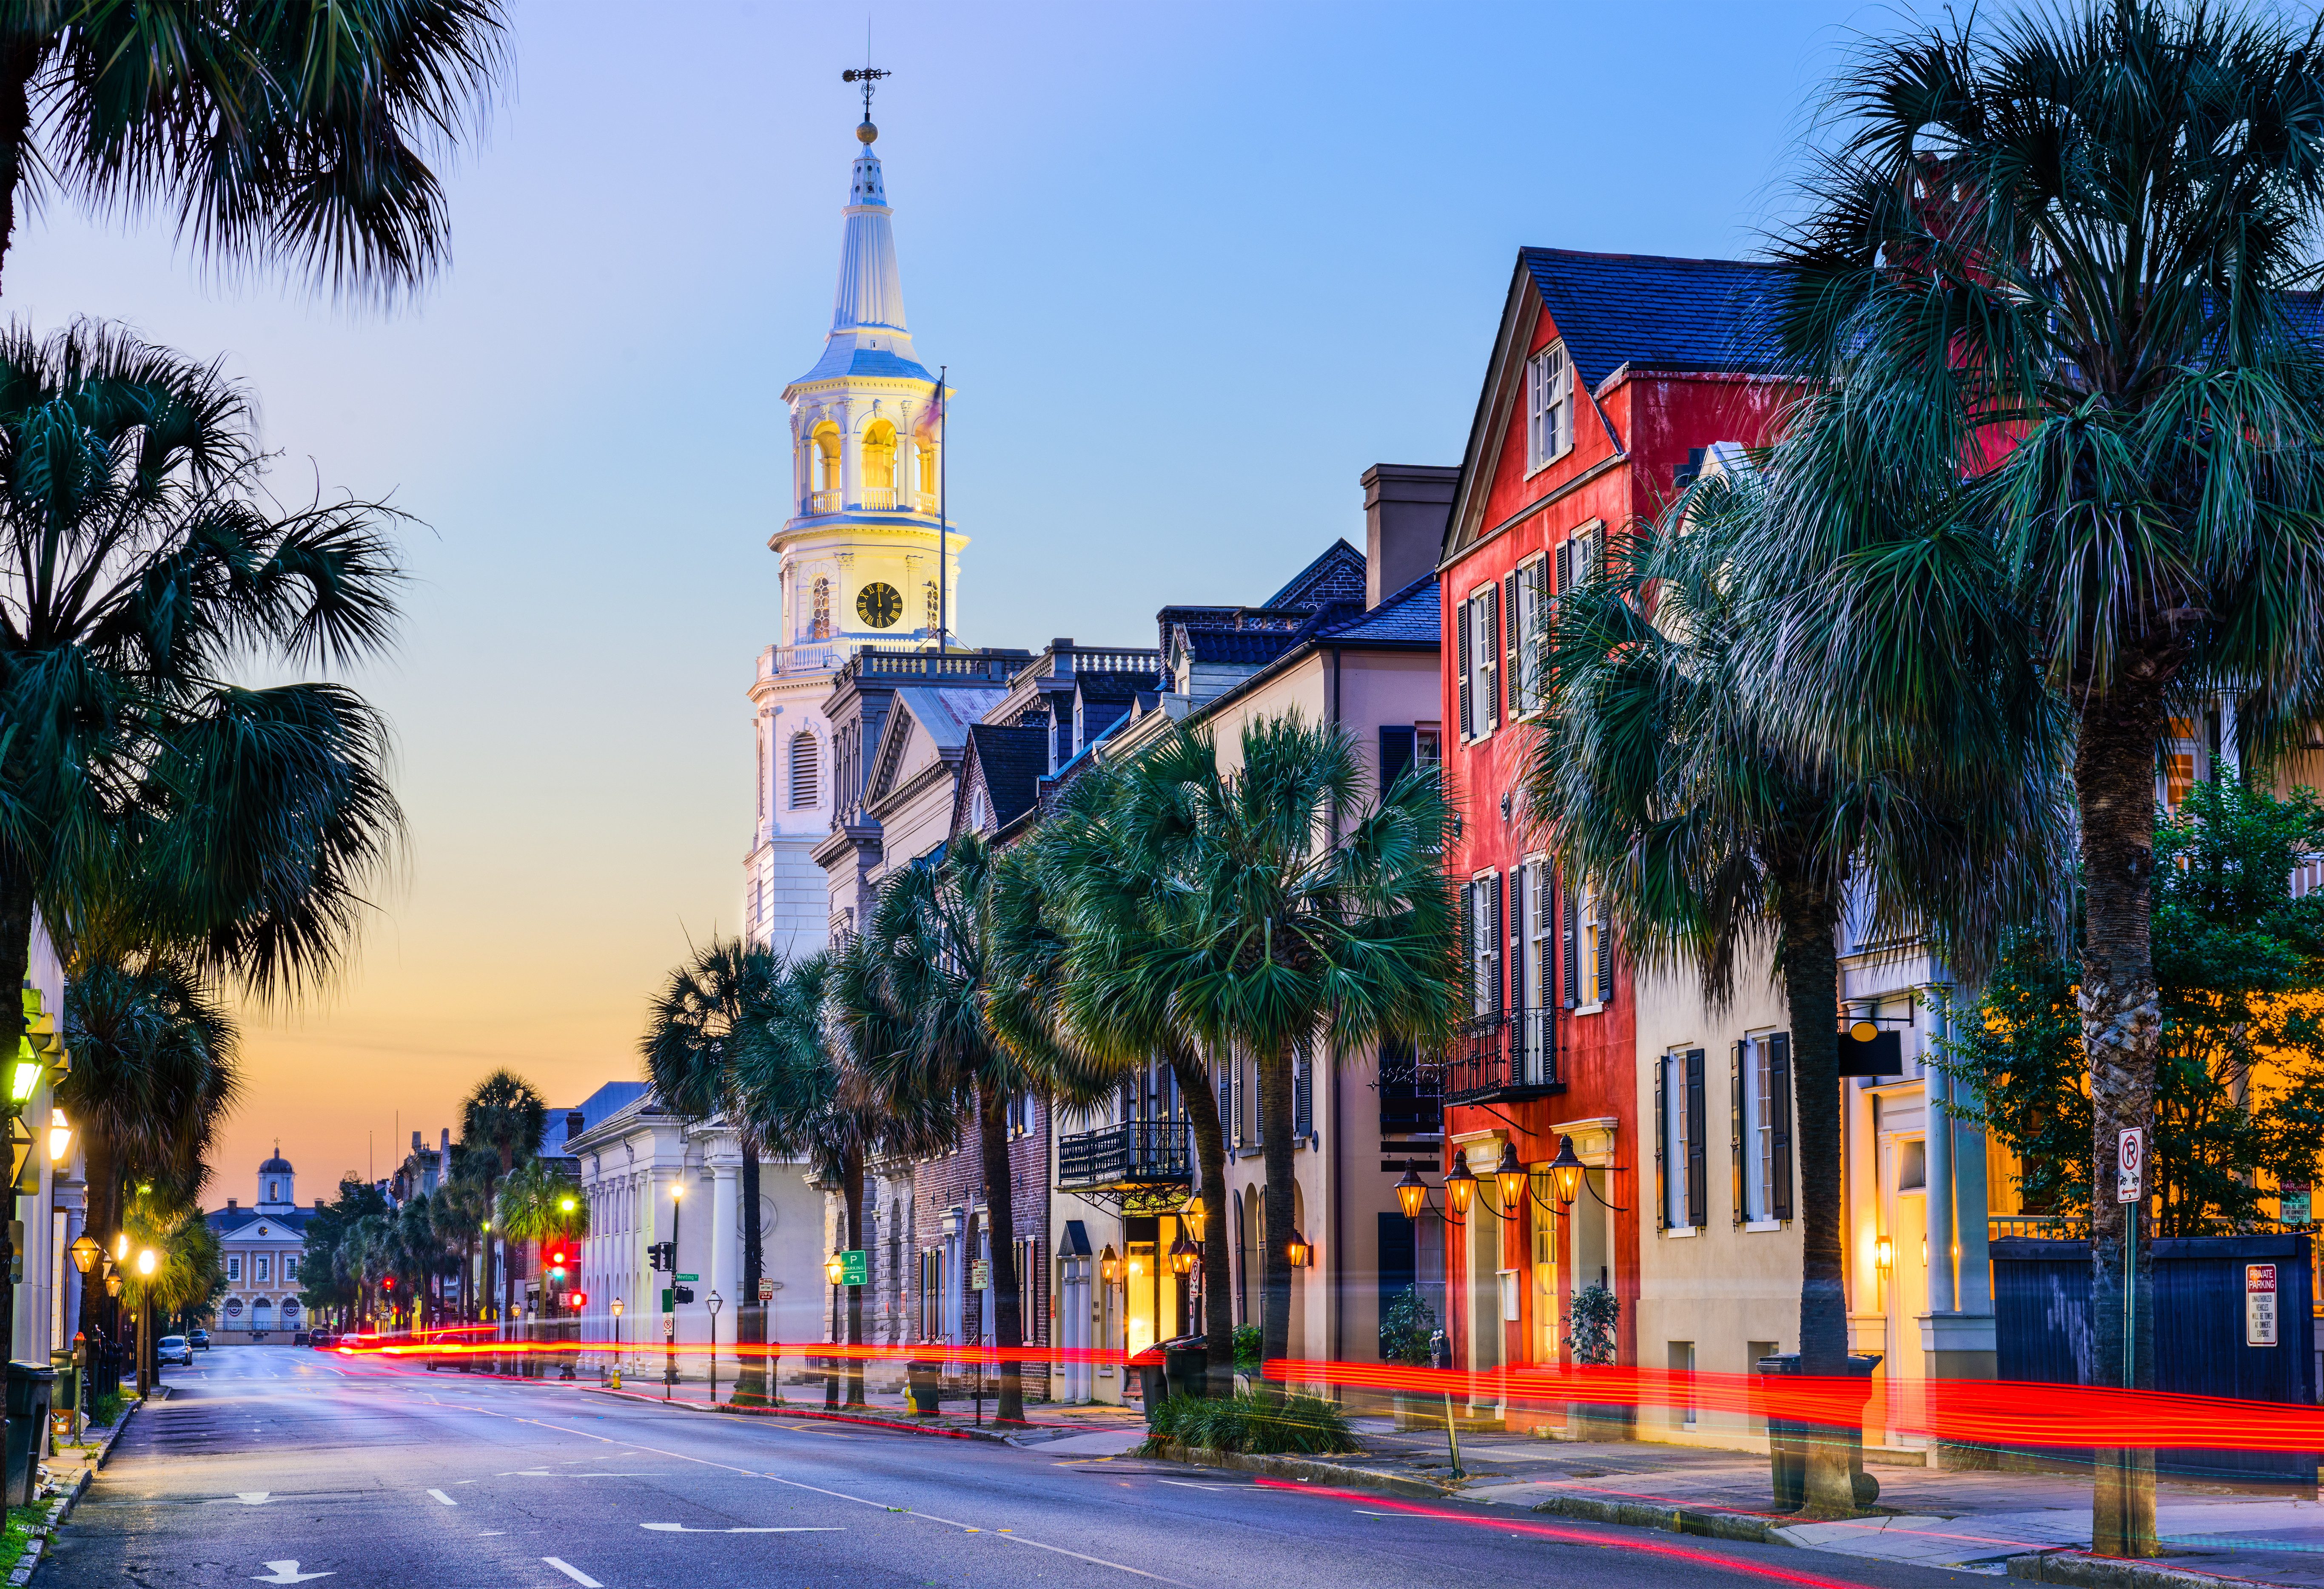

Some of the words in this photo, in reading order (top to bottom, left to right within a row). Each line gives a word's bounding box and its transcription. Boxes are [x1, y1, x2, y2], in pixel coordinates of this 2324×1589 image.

[866, 585, 875, 595] XI
[886, 586, 891, 594] I
[860, 592, 869, 600] X
[859, 608, 870, 620] VIII
[889, 609, 900, 620] IIII
[866, 615, 874, 625] VII
[877, 619, 883, 627] VI
[886, 617, 892, 625] V
[2127, 1142, 2136, 1164] P
[850, 1255, 857, 1264] P
[2250, 1269, 2273, 1279] PRIVATE
[2249, 1280, 2274, 1289] PARKING
